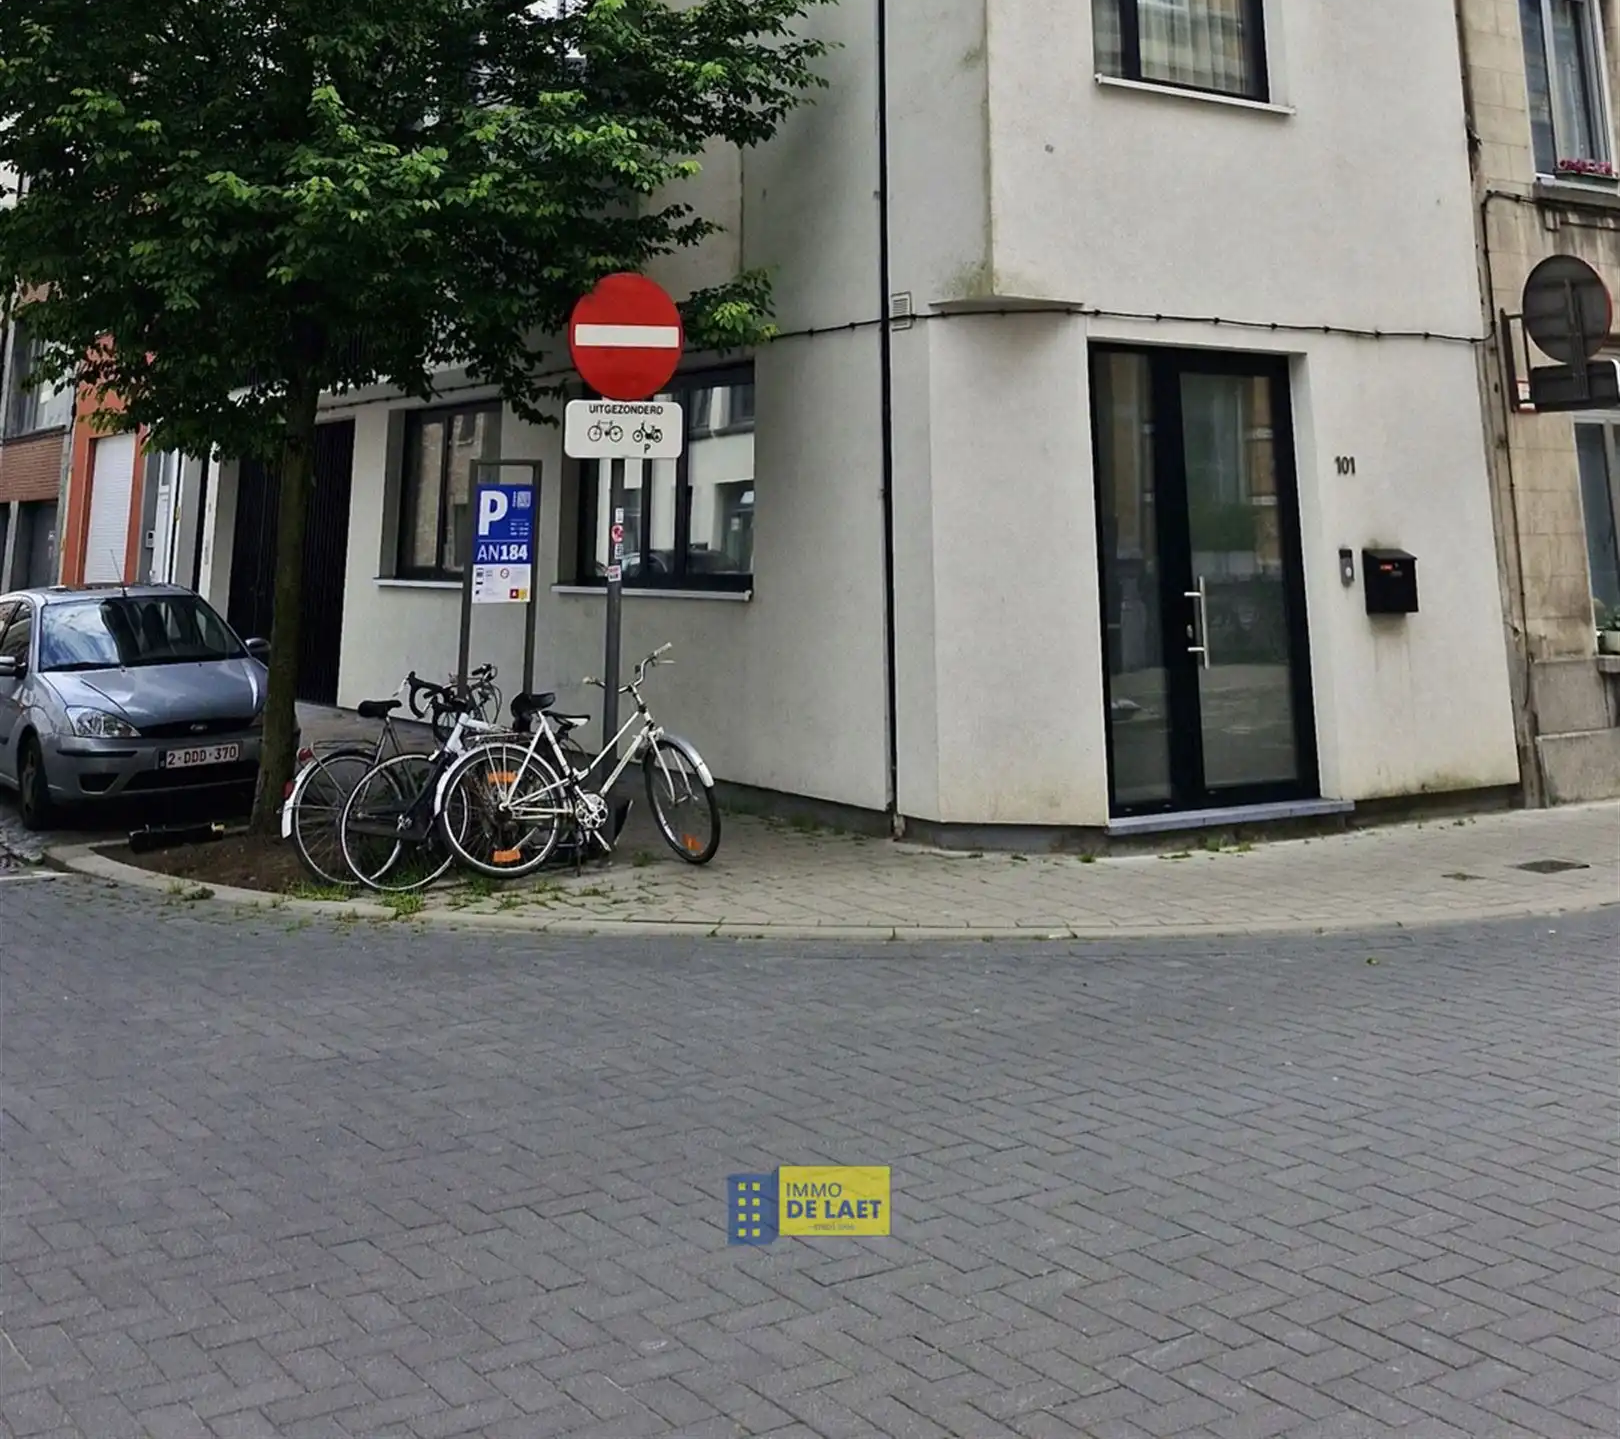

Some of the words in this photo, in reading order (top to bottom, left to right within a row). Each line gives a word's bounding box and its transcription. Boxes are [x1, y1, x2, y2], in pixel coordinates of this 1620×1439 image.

[588, 404, 664, 415] UITGEZONDERD
[644, 443, 651, 454] P
[1335, 456, 1356, 475] 101
[478, 490, 509, 536] P
[477, 544, 528, 561] AN184
